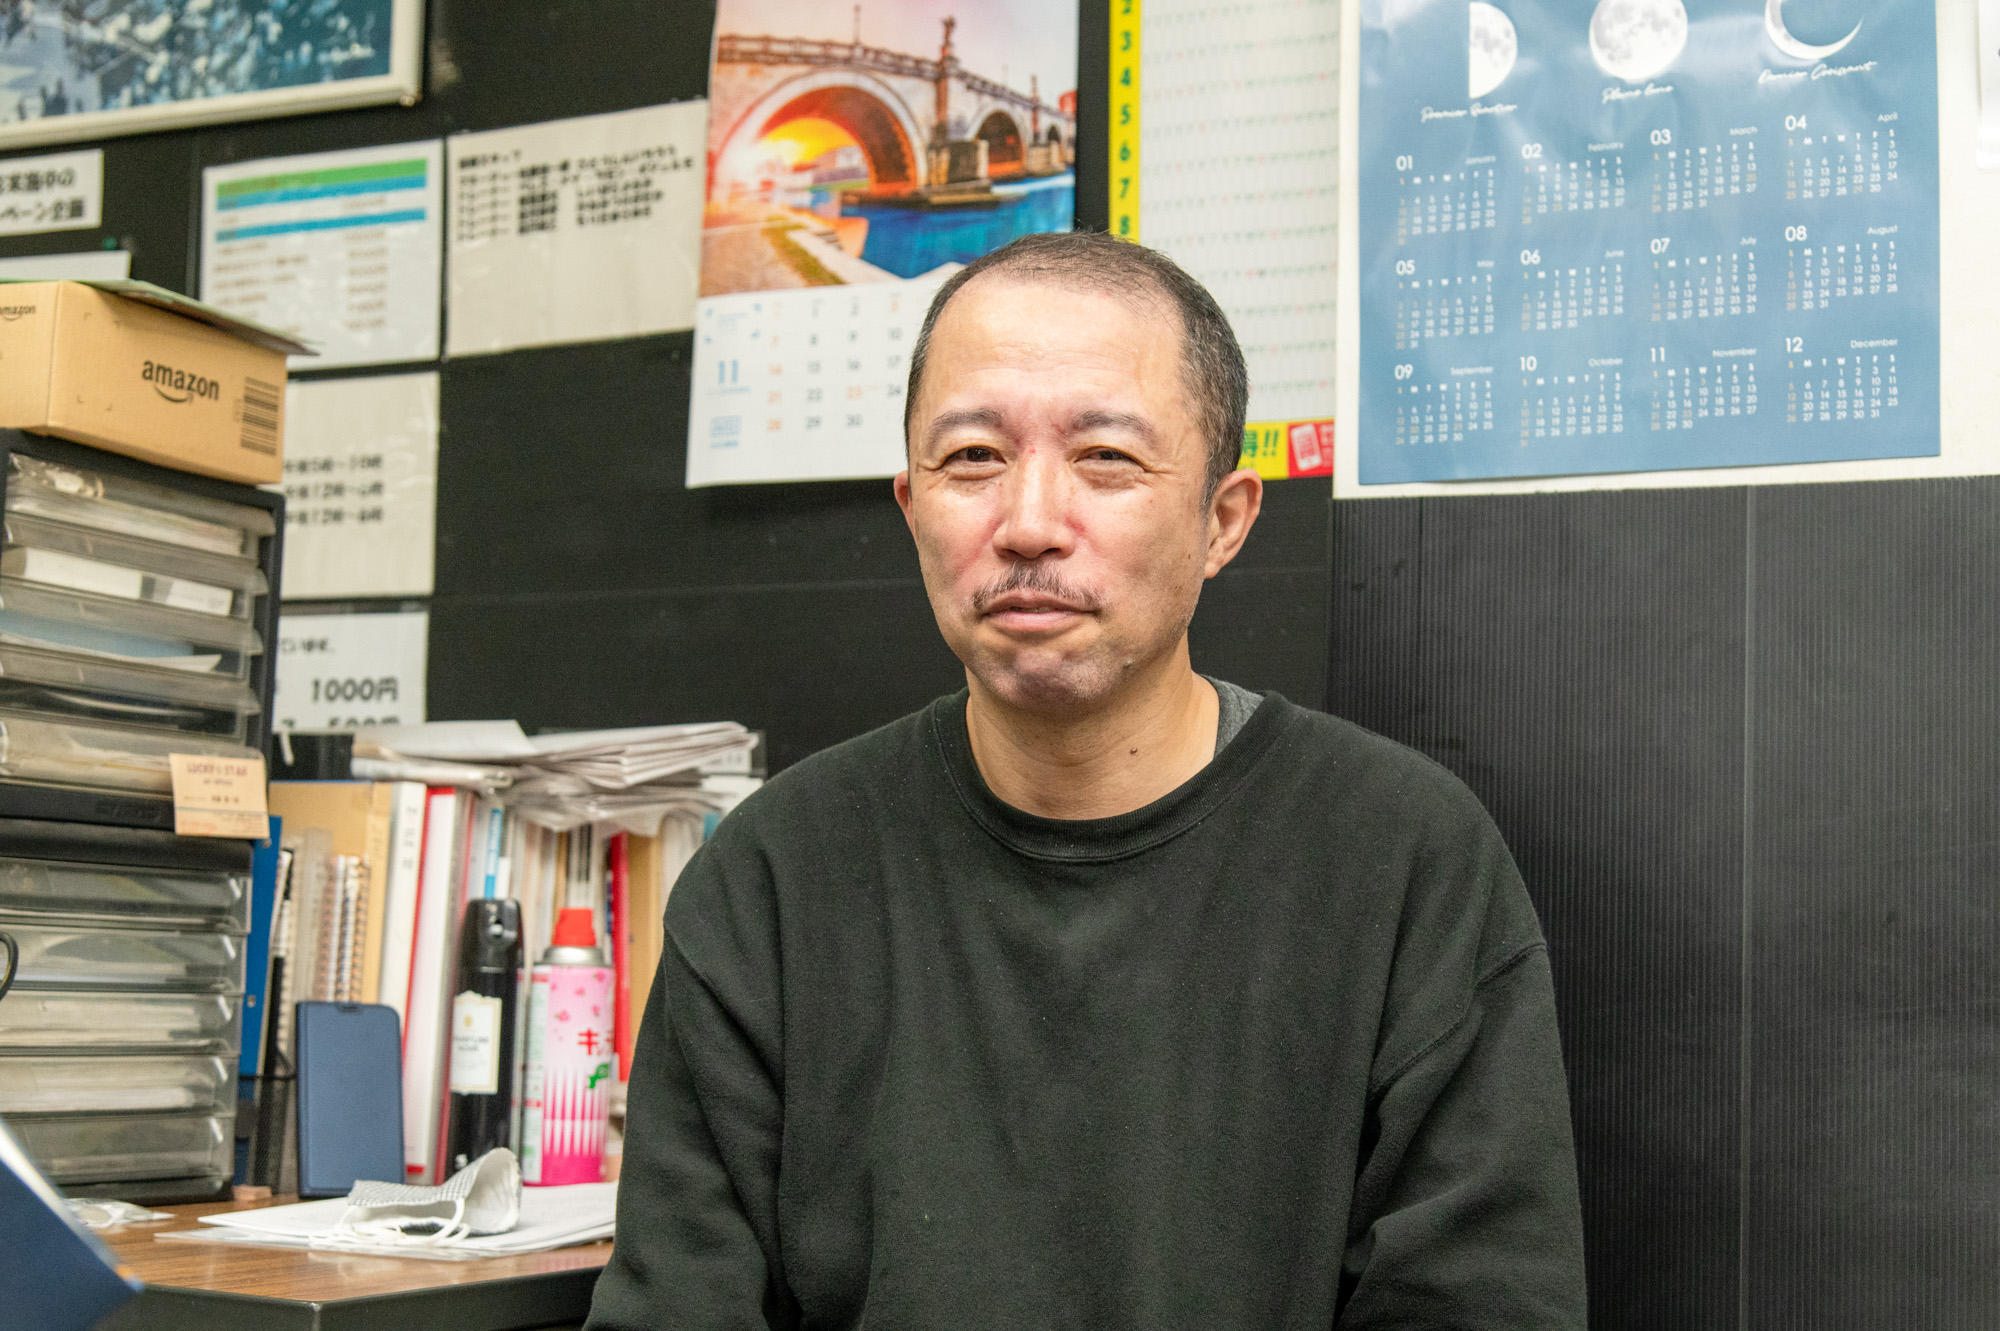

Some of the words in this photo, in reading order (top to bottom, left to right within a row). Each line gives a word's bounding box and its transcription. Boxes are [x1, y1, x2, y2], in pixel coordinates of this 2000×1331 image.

[1121, 31, 1132, 52] 3
[1120, 67, 1131, 87] 4
[1120, 104, 1131, 125] 5
[1785, 115, 1807, 131] 04
[1877, 112, 1898, 122] April
[1650, 129, 1671, 146] 03
[1119, 142, 1131, 162] 6
[1521, 144, 1542, 160] 02
[1396, 155, 1413, 171] 01
[1119, 178, 1131, 199] 7
[1119, 215, 1130, 236] 8
[1785, 225, 1807, 241] 08
[1867, 224, 1898, 236] August
[1650, 238, 1670, 254] 07
[1520, 249, 1541, 266] 06
[1396, 259, 1415, 275] 05
[1785, 337, 1803, 353] 12
[1850, 339, 1898, 349] December
[1650, 347, 1665, 363] 11
[1395, 364, 1413, 380] 09
[1520, 356, 1537, 372] 10
[142, 360, 220, 401] amazon
[312, 678, 398, 702] 1000円
